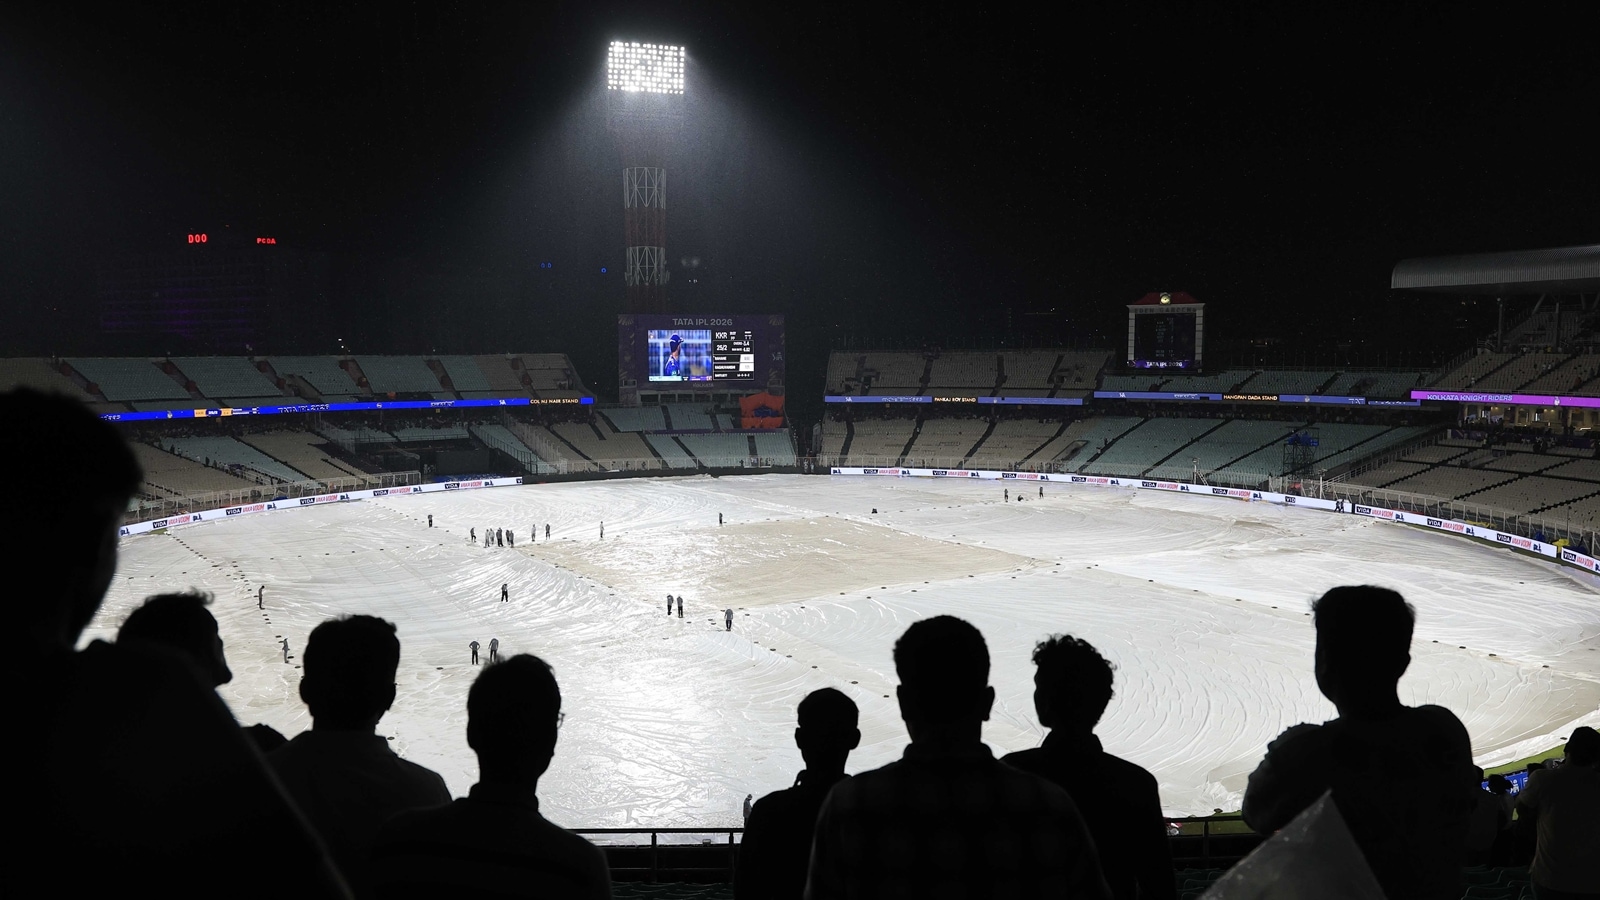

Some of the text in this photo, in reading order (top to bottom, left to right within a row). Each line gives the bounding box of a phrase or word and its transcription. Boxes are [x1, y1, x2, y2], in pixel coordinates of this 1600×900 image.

[1521, 540, 1531, 548] VOOM
[1564, 552, 1575, 560] VIDA
[1584, 558, 1594, 568] VOOM
